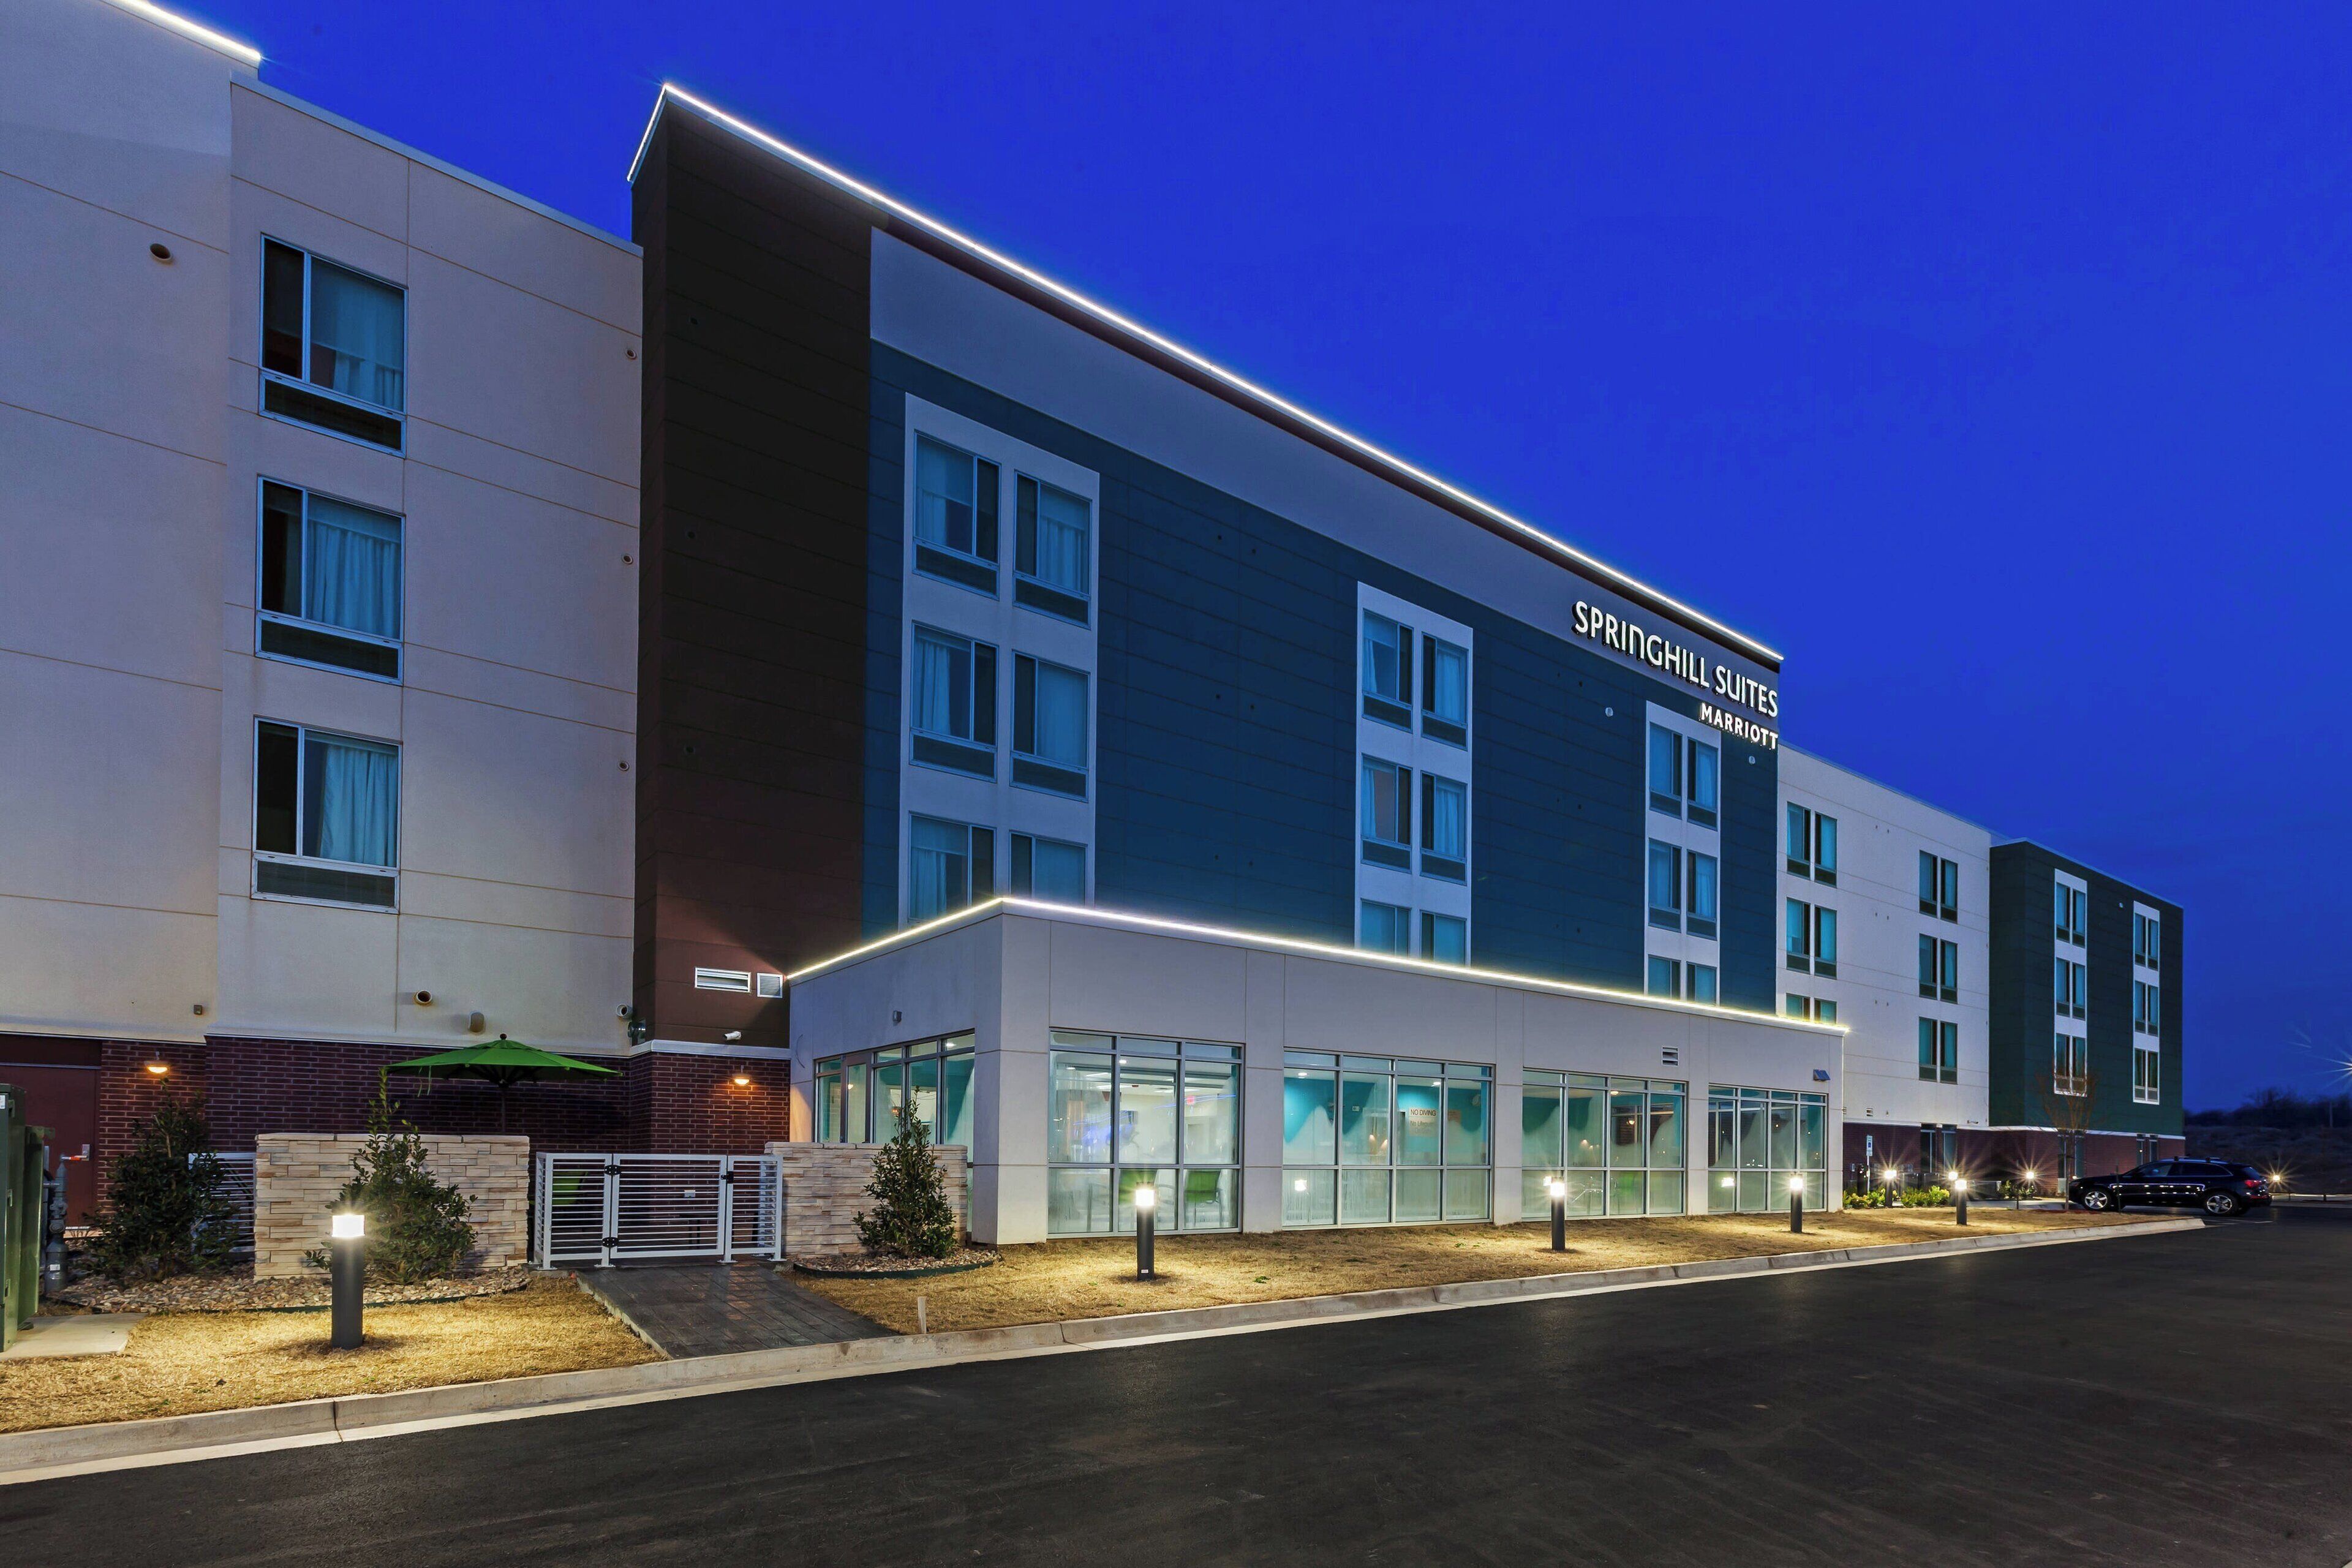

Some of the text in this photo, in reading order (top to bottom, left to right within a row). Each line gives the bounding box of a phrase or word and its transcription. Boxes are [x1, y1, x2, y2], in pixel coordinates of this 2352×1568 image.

[1572, 600, 1777, 718] SPRINGHILL SUITES
[1700, 702, 1778, 750] MARRIOTT
